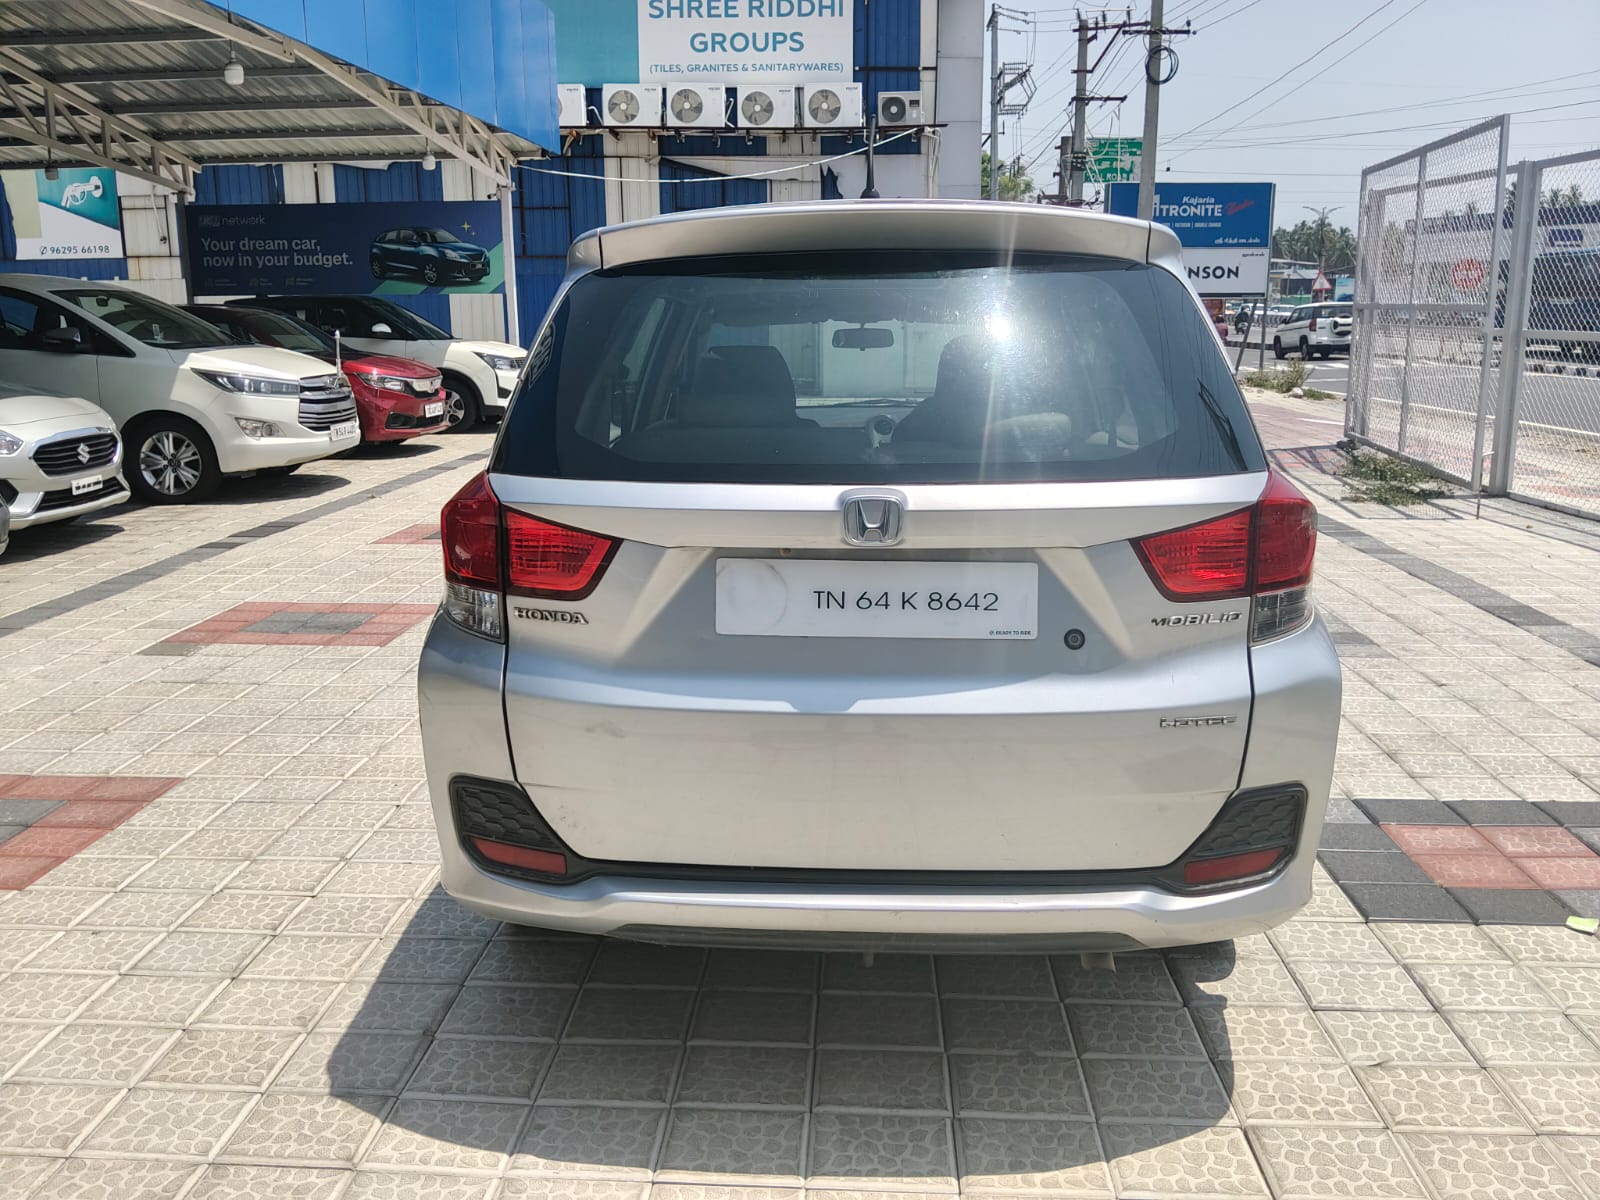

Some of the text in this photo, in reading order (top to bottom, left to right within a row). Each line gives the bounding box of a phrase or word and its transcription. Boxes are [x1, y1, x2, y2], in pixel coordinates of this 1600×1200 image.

[648, 0, 844, 18] SHREE RIDDHI
[690, 32, 805, 52] GROUPS
[650, 63, 844, 74] (TILES, GRANITES & SANITARYWARES)
[1182, 195, 1215, 206] Kajaria
[222, 215, 266, 226] network
[50, 245, 110, 255] 96295 66198
[201, 237, 321, 252] Your dream car,
[203, 253, 353, 269] now in your budget.
[1184, 265, 1240, 279] NSON
[813, 590, 1000, 611] TN 64 K 8642
[513, 606, 589, 625] HONDA
[1151, 611, 1243, 627] MOBILIO
